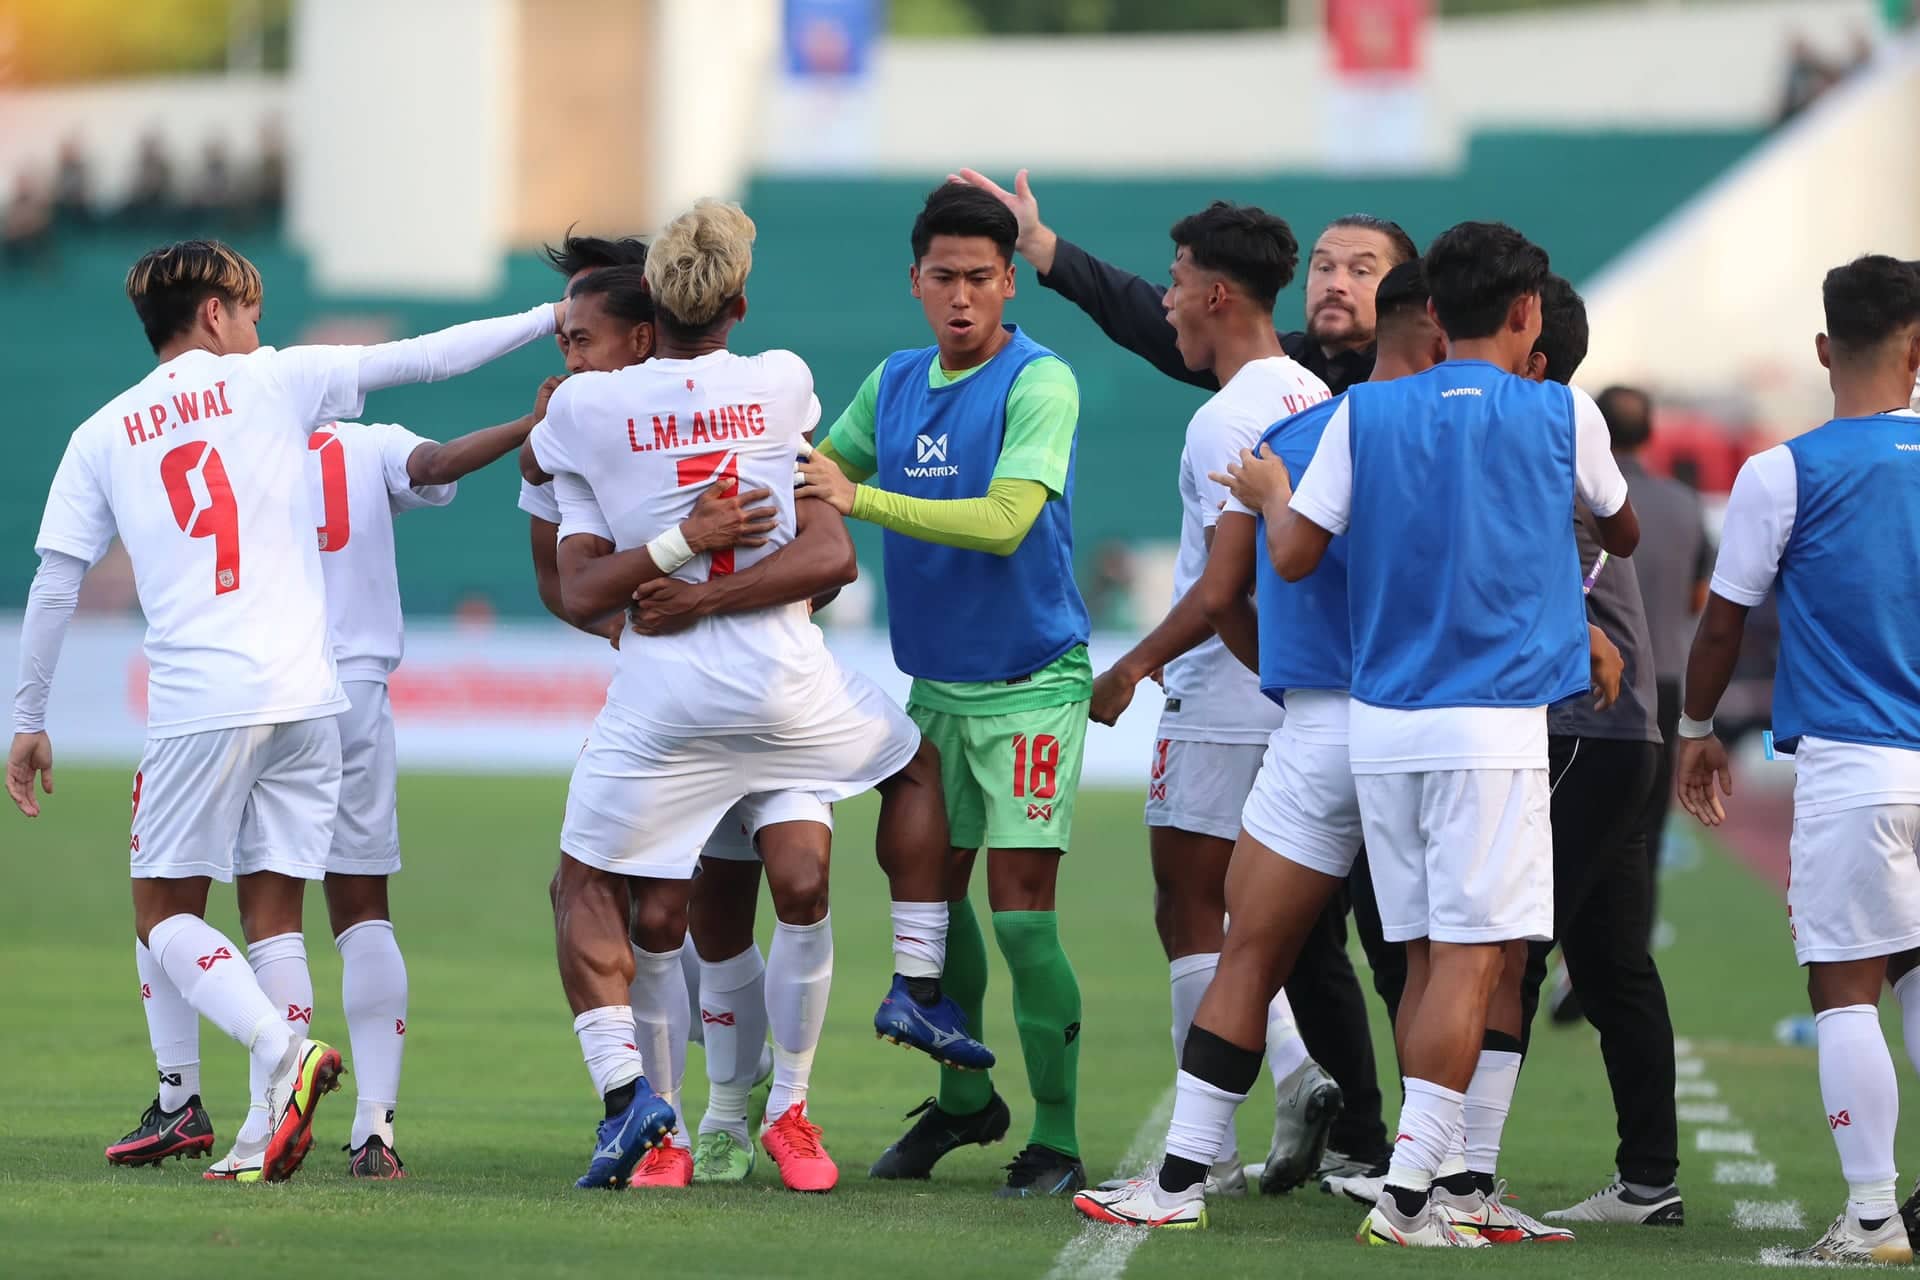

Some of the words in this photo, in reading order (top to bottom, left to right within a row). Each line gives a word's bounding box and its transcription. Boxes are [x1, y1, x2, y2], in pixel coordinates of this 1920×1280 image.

[123, 381, 232, 446] H.P.WAI
[1441, 387, 1482, 399] WARRIX
[627, 404, 765, 452] L.M.AUNG
[904, 465, 959, 478] WARRIX
[160, 440, 240, 595] 9
[1012, 733, 1059, 798] 18
